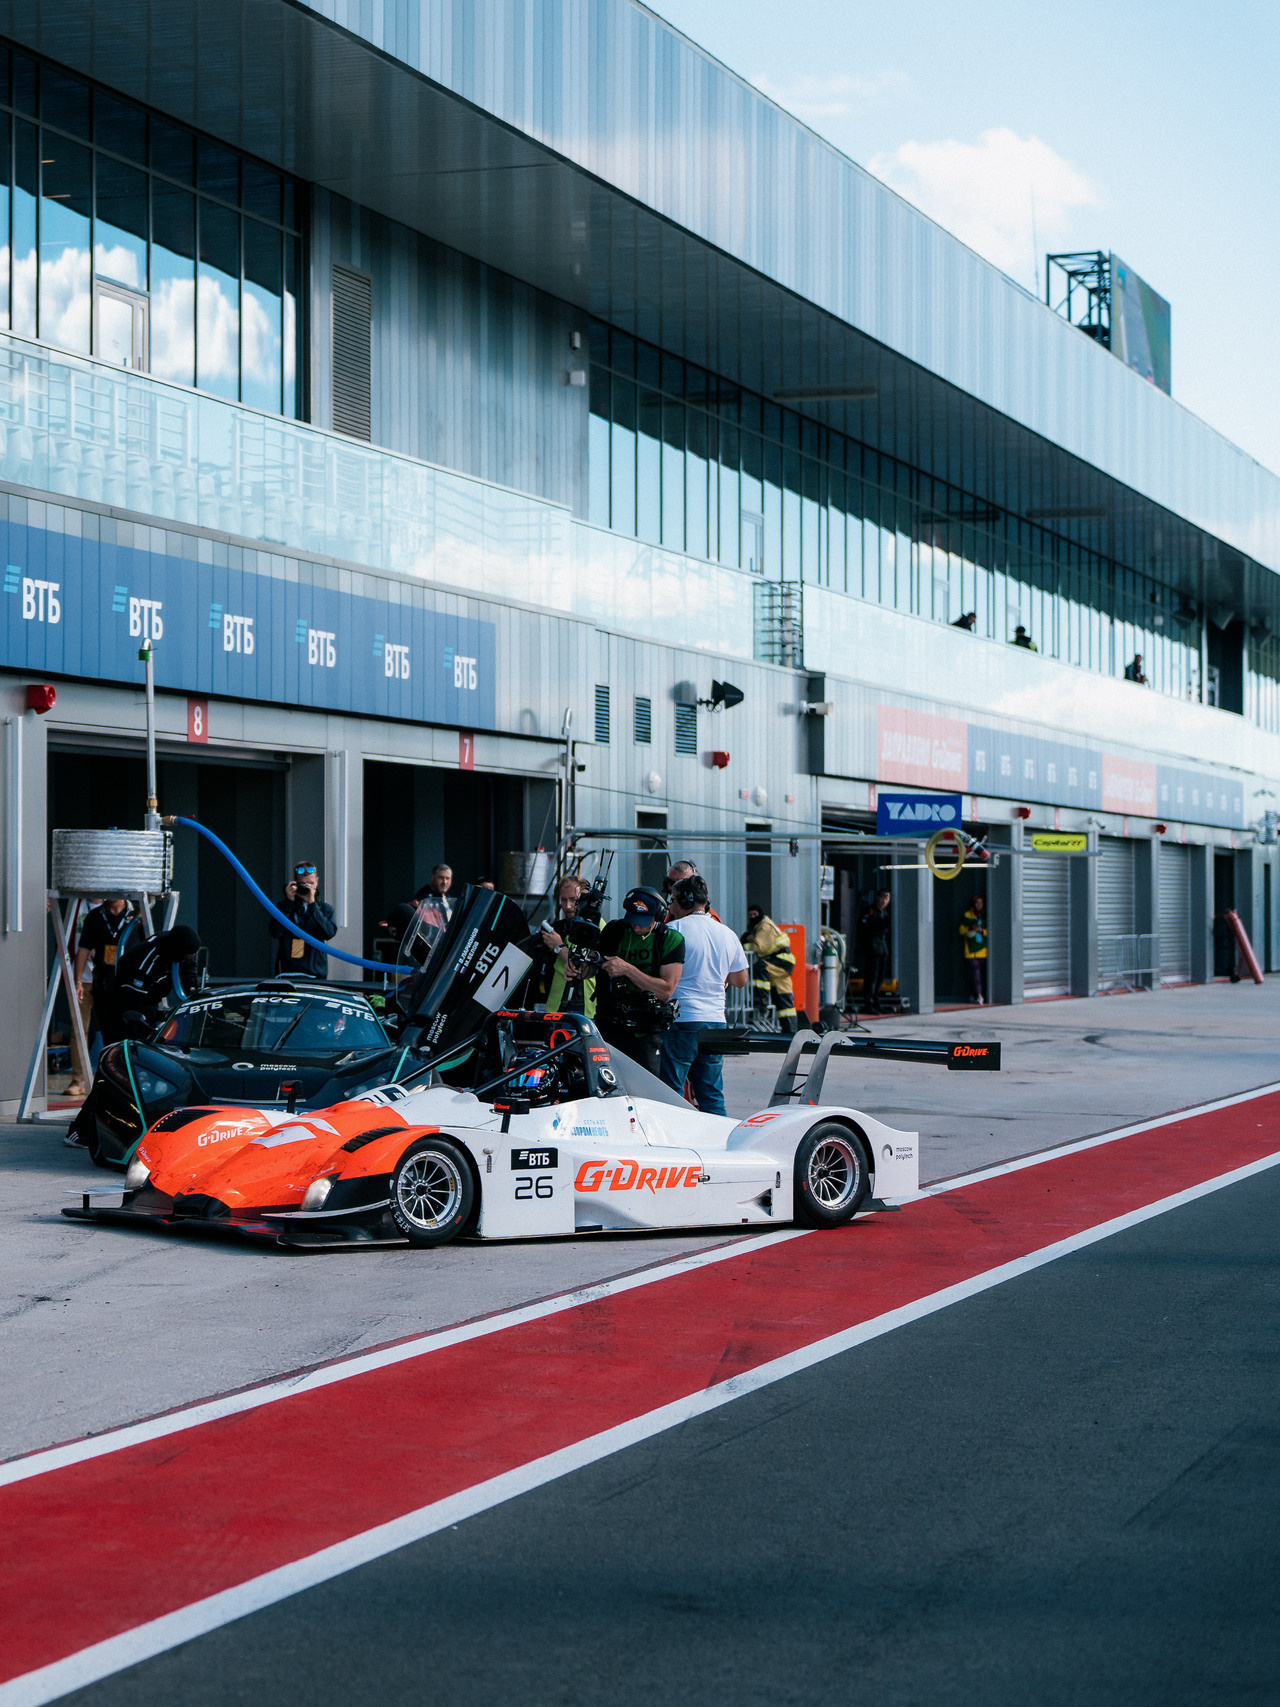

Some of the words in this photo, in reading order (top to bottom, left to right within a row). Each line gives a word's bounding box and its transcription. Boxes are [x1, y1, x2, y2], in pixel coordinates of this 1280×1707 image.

[22, 577, 61, 624] ВТБ
[129, 596, 163, 641] ВТБ
[223, 614, 254, 655] ВТБ
[308, 628, 336, 668] ВТБ
[384, 642, 410, 680] ВТБ
[454, 654, 477, 691] ВТБ
[193, 706, 202, 737] 8
[463, 738, 470, 764] 7
[885, 802, 956, 822] YADRO
[475, 942, 500, 974] ВТБ
[189, 1001, 223, 1014] ВТБ
[342, 1006, 375, 1022] ВТБ
[528, 1151, 550, 1166] ВТБ
[514, 1175, 554, 1200] 26
